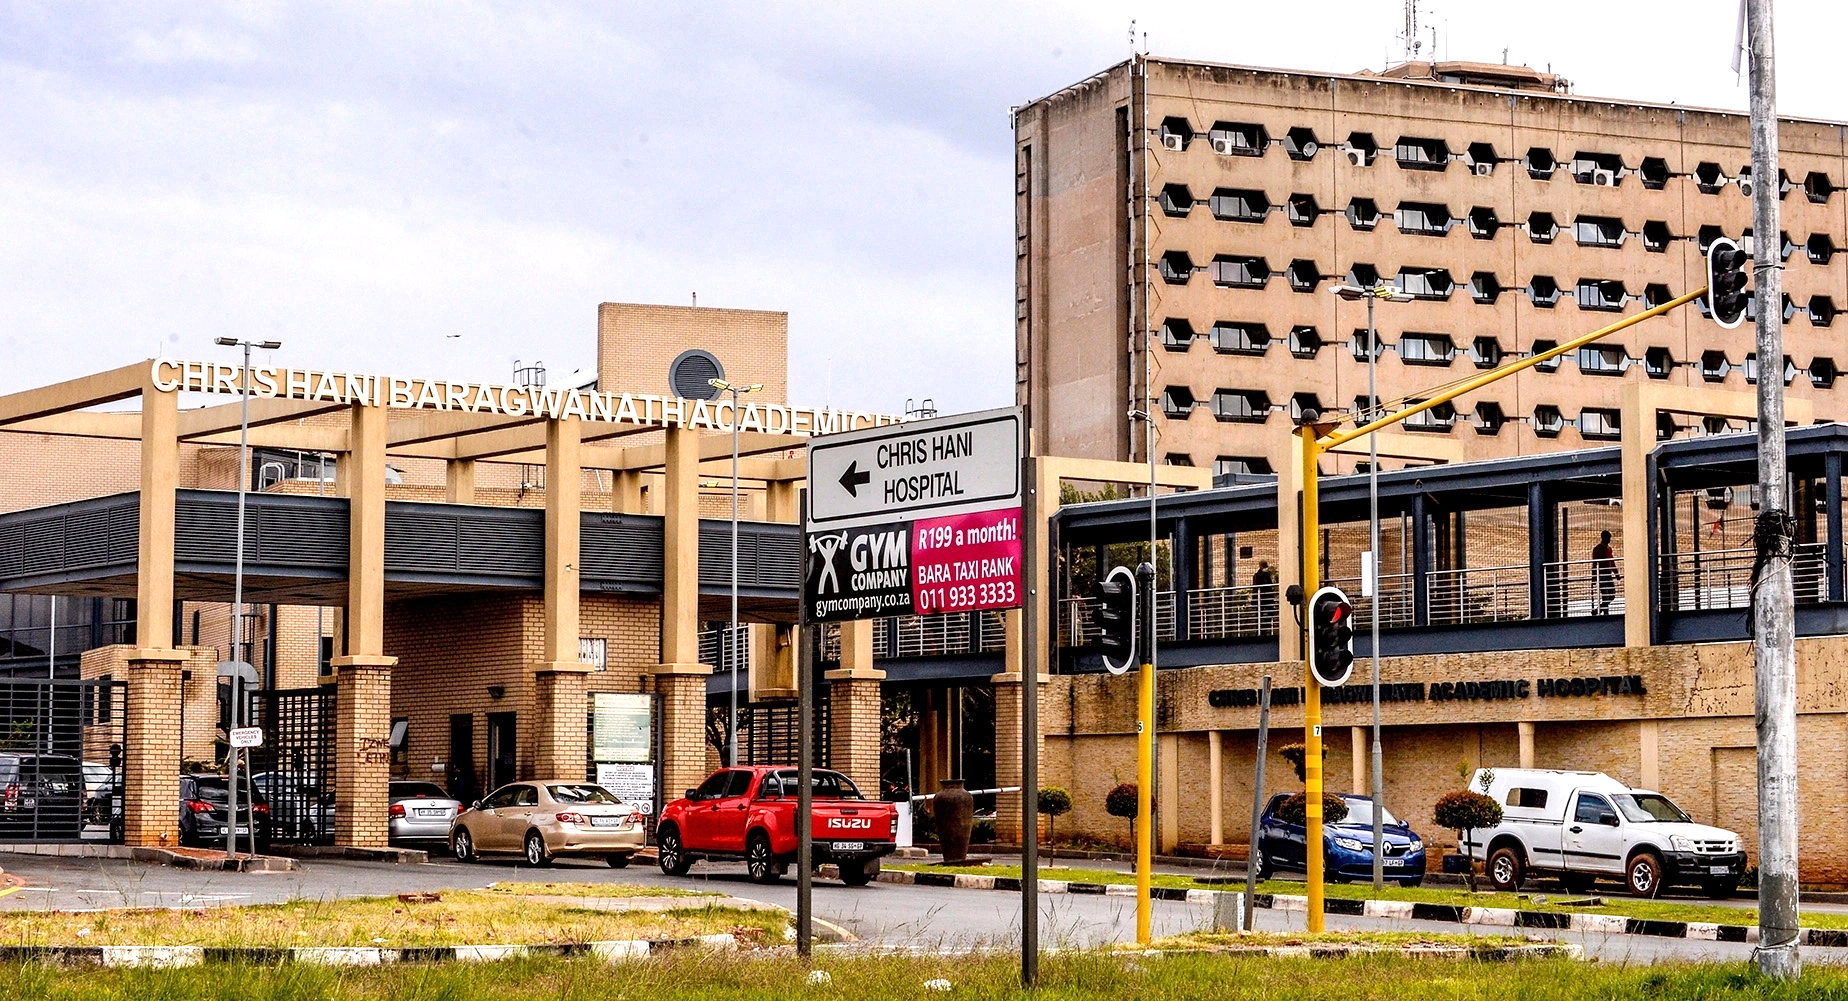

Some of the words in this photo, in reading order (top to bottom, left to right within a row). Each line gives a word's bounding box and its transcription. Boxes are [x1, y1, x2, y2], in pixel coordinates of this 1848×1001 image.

[286, 366, 382, 407] HANI
[389, 375, 685, 429] BARAGWANATH
[688, 398, 872, 437] ACADEMIC
[877, 438, 927, 469] CHRIS
[932, 431, 973, 461] HANI
[884, 470, 964, 504] HOSPITAL
[918, 525, 951, 550] R199
[956, 532, 964, 546] a
[967, 518, 1017, 545] month!
[851, 530, 907, 572] GYM
[851, 569, 908, 592] COMPANY
[918, 562, 951, 585] BARA
[953, 560, 979, 581] TAXI
[981, 556, 1014, 577] RANK
[816, 592, 910, 618] gymcompany.co.za
[920, 586, 946, 610] 011
[950, 585, 977, 607] 933
[979, 581, 1015, 605] 3333
[1429, 679, 1530, 700] ACADEMIC
[1537, 675, 1647, 697] HOSPITAL
[1315, 726, 1320, 735] 7
[828, 818, 871, 828] ISUZU
